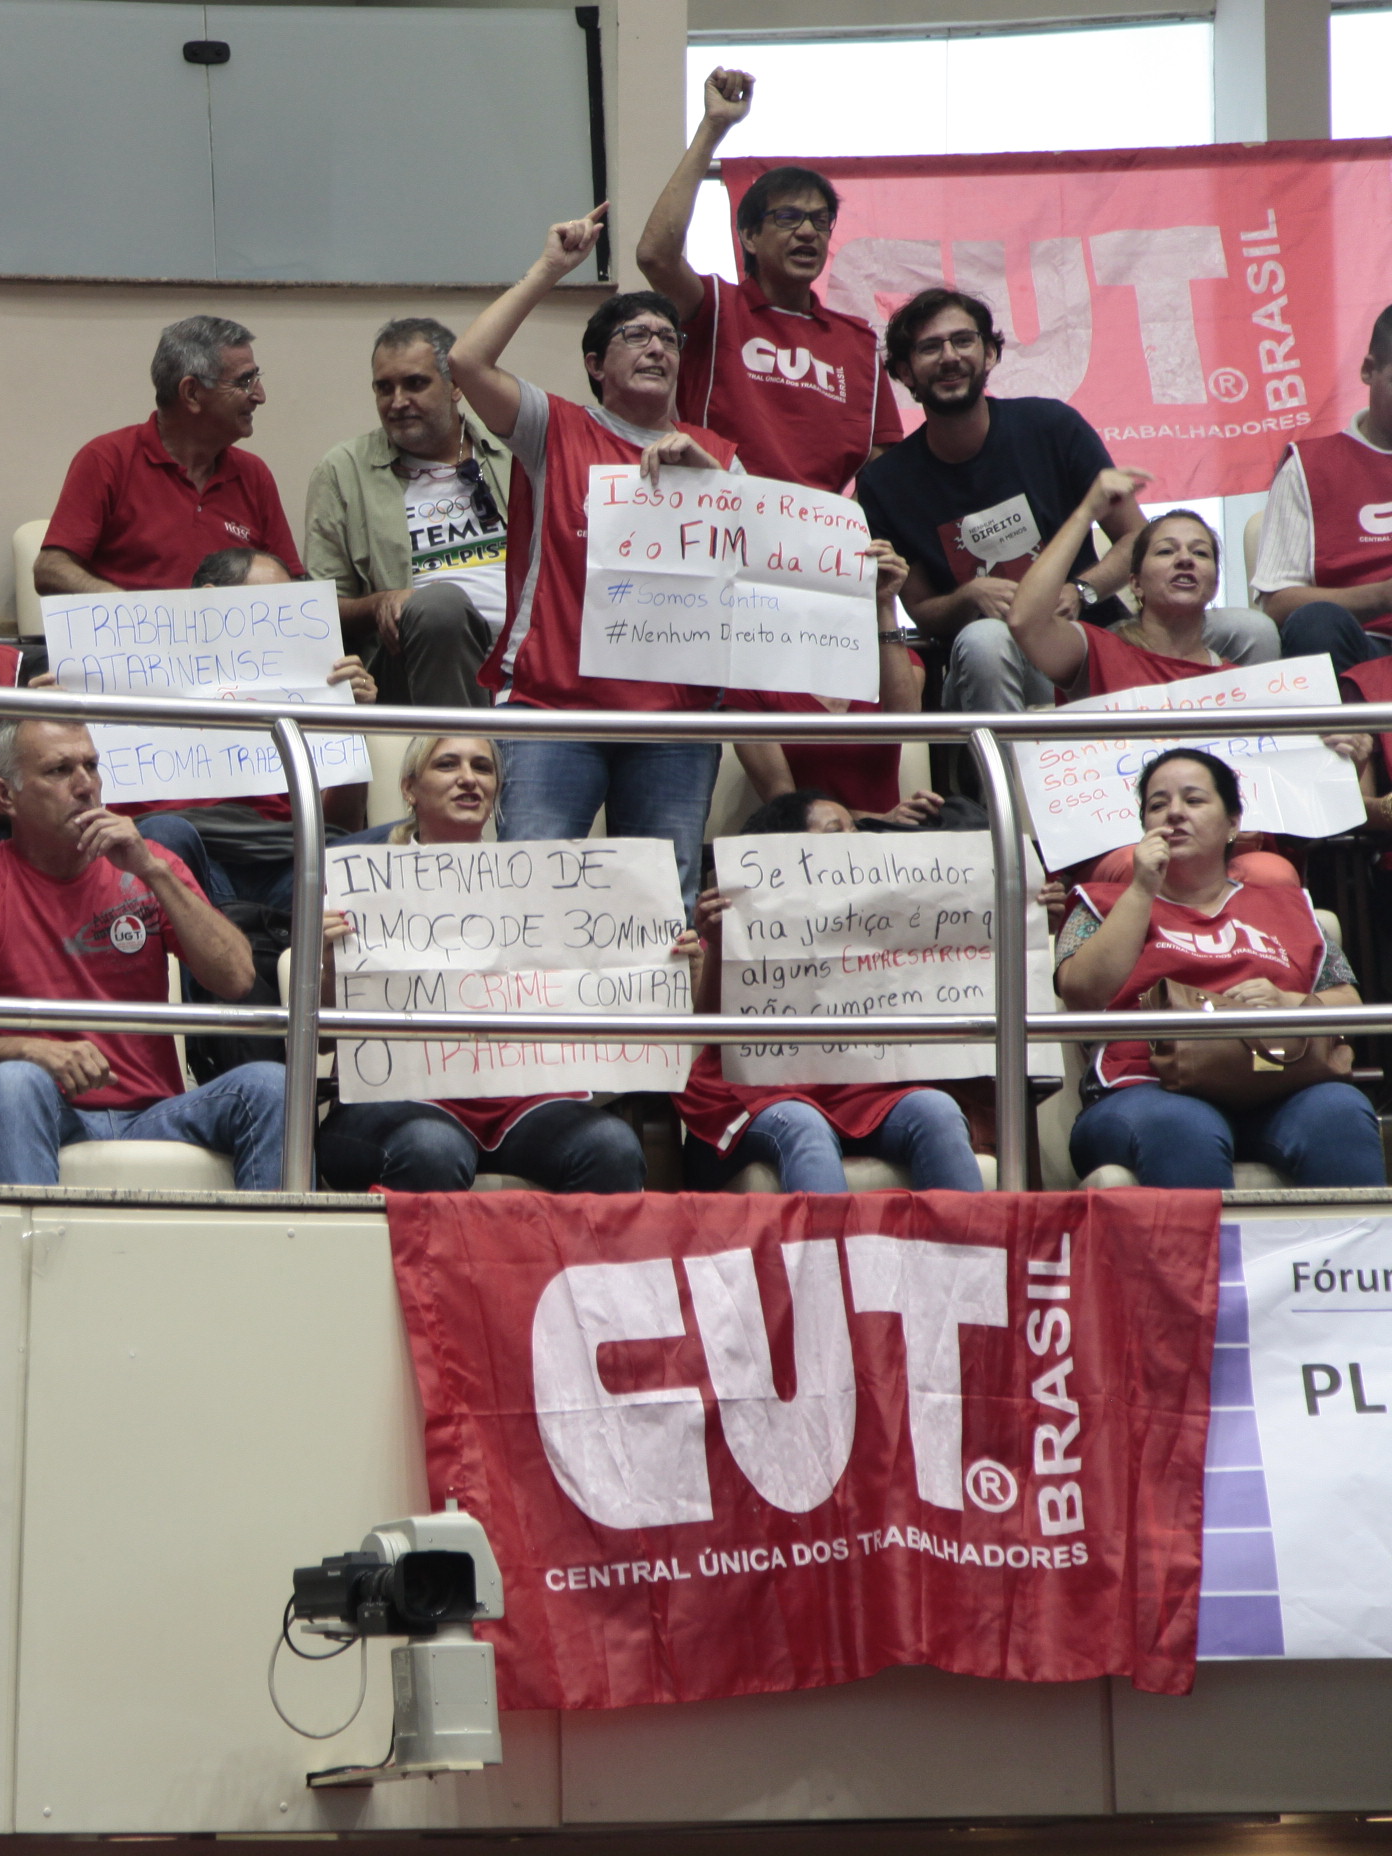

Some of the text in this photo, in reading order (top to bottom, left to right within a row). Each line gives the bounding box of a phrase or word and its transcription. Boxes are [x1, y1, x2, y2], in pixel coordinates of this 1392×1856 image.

[826, 225, 1229, 410] CUT
[1240, 208, 1308, 412] BRASIL
[741, 337, 835, 391] CUT
[600, 474, 684, 510] Isso
[697, 489, 743, 512] não
[756, 495, 766, 515] é
[409, 518, 508, 552] TEME
[971, 513, 1022, 543] DIREITO
[618, 520, 869, 582] é o FIM da CLT
[720, 622, 775, 644] Direito
[781, 631, 792, 644] a
[800, 630, 860, 651] menos
[1267, 672, 1310, 695] de
[1048, 788, 1108, 815] essa
[332, 849, 618, 897] INTERVALO DE
[739, 848, 975, 890] Se trabalhador
[114, 931, 141, 942] UGT
[746, 919, 788, 942] na
[800, 903, 895, 947] justiça
[909, 906, 921, 929] é
[935, 909, 973, 940] por
[1157, 918, 1270, 954] CUT
[741, 942, 993, 990] alguns EMPRESÁRIOS
[385, 971, 447, 1013] UM
[458, 970, 565, 1012] CRIME
[578, 970, 690, 1010] CONTRA
[937, 984, 984, 1004] com
[355, 1039, 393, 1087] O
[531, 1234, 1009, 1530] CUT
[1027, 1232, 1085, 1537] BRASIL
[1302, 1362, 1388, 1416] PL
[545, 1526, 1089, 1591] CENTRAL ÚNICA DOS TRABALHADORES
